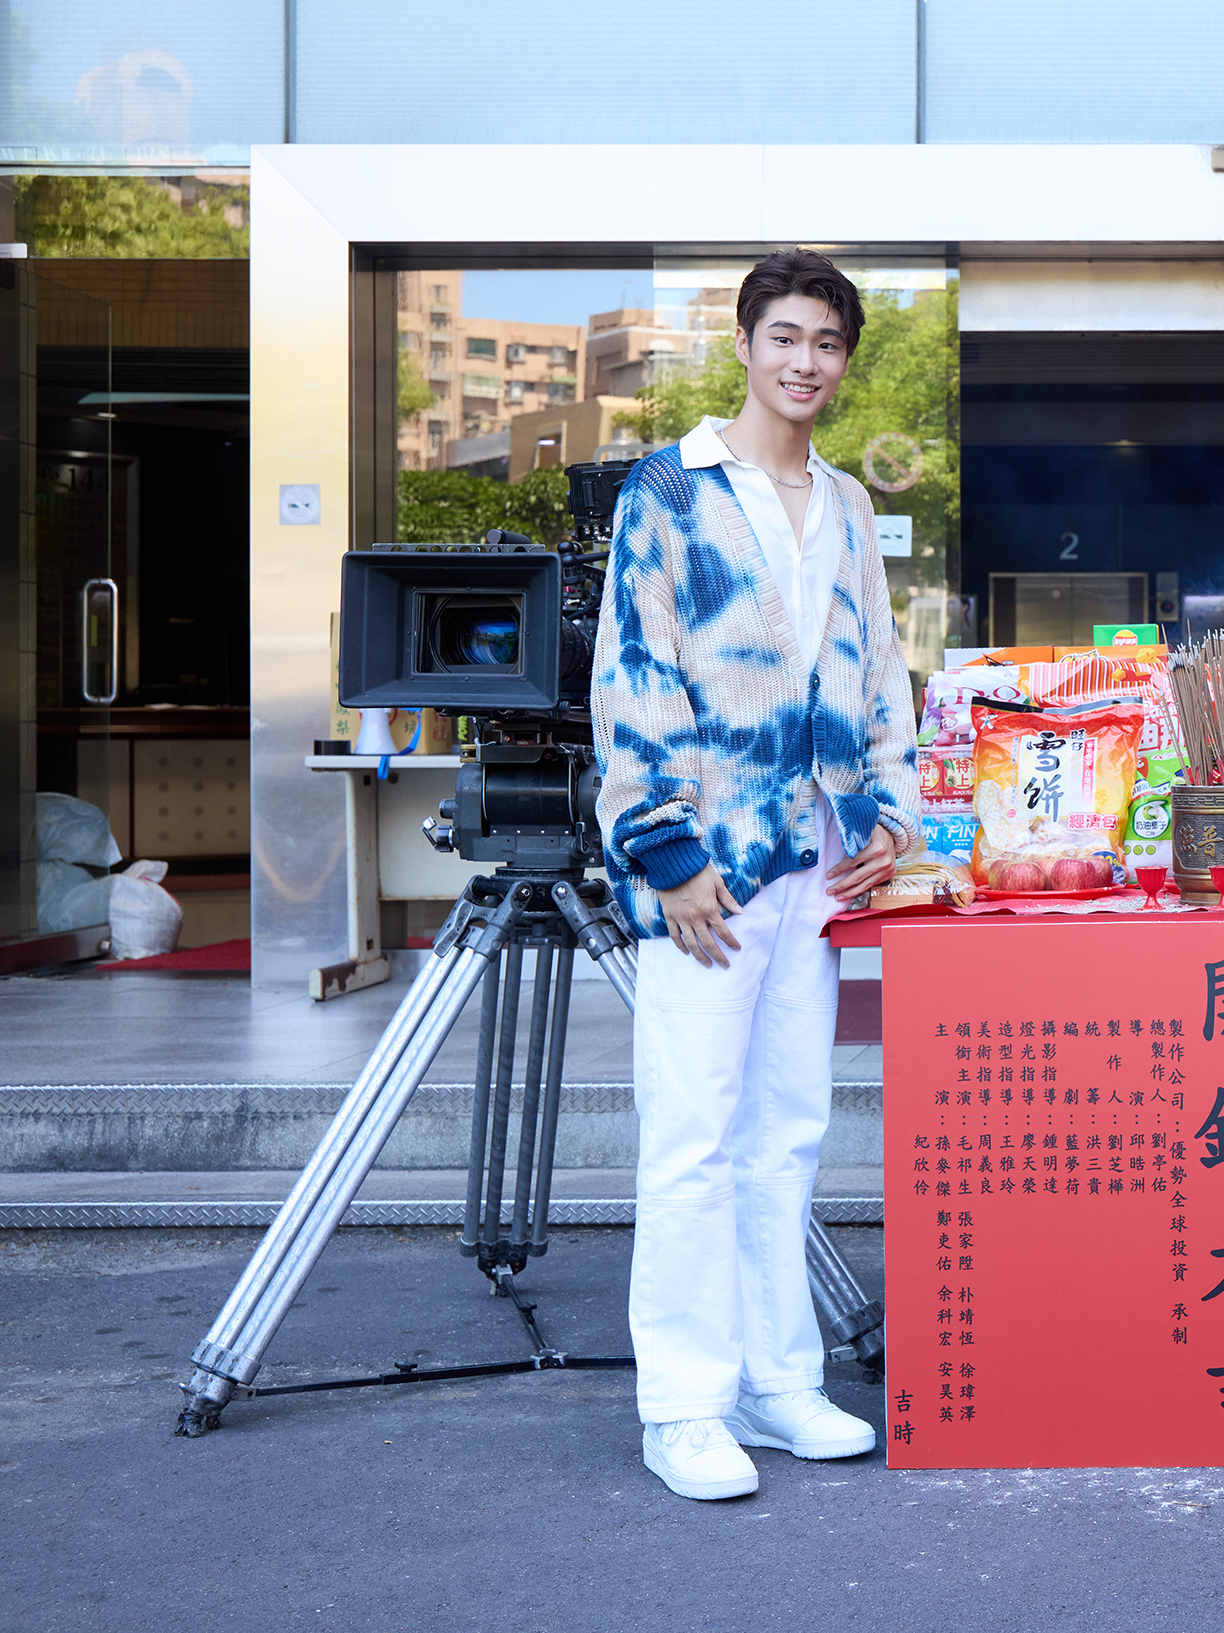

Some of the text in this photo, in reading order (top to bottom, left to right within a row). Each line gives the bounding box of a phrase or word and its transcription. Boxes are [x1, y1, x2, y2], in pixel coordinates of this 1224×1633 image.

[1060, 532, 1079, 561] 2
[955, 759, 970, 787] 特上
[1068, 814, 1117, 829] 經濟包
[937, 1285, 953, 1346] 余科宏
[1171, 1303, 1188, 1344] 承制
[959, 1363, 976, 1422] 徐瑋澤
[894, 1389, 915, 1445] 吉時
